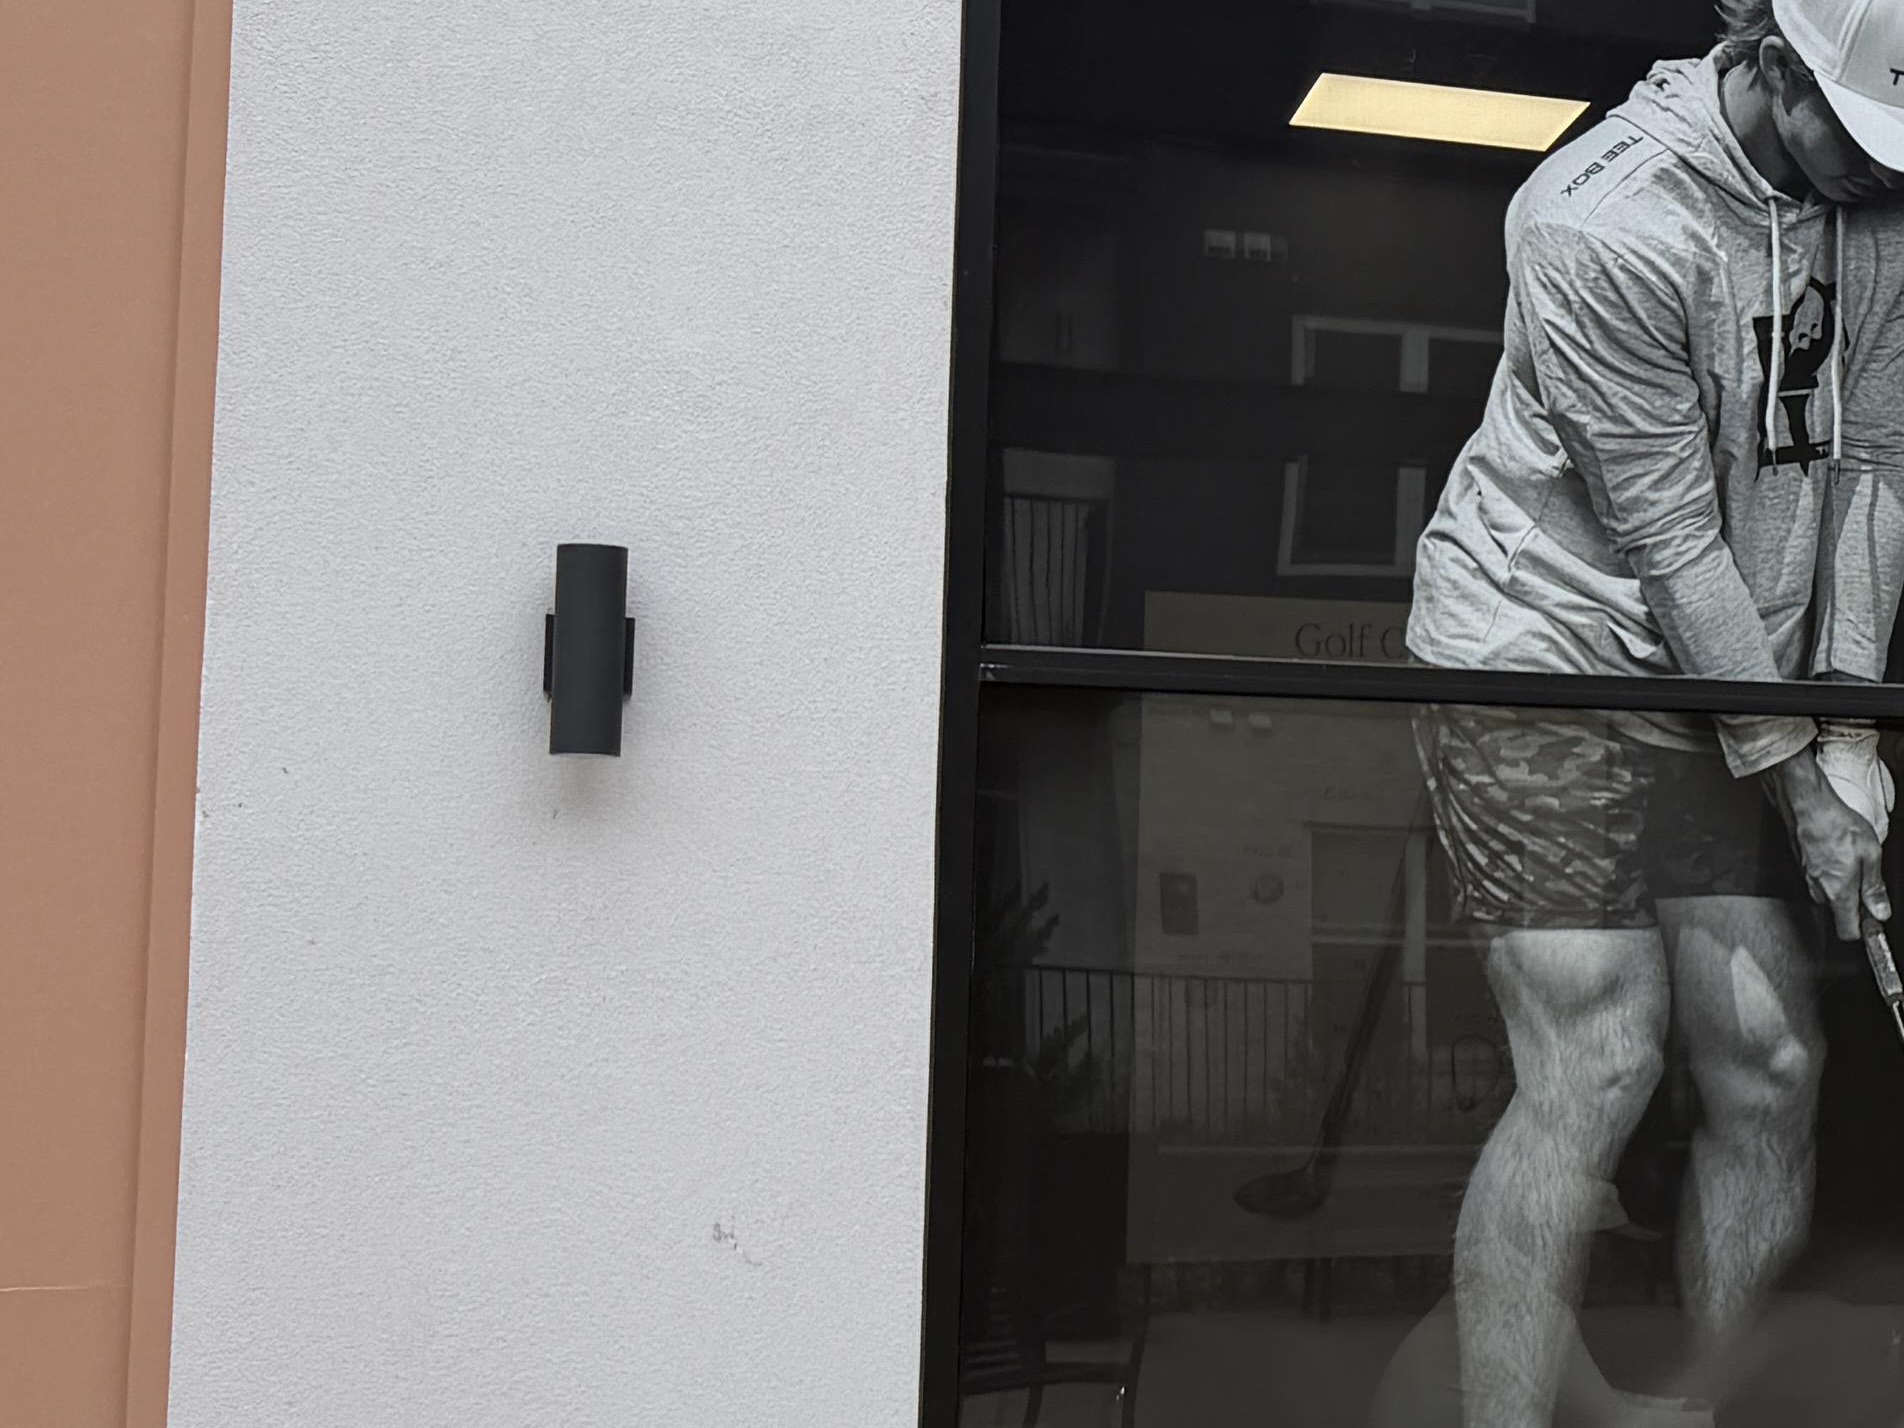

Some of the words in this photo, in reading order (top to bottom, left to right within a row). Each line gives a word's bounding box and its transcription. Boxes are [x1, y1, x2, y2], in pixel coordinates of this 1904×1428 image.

[1601, 135, 1644, 163] TEE
[1560, 162, 1605, 197] BOX
[1293, 622, 1372, 659] Golf
